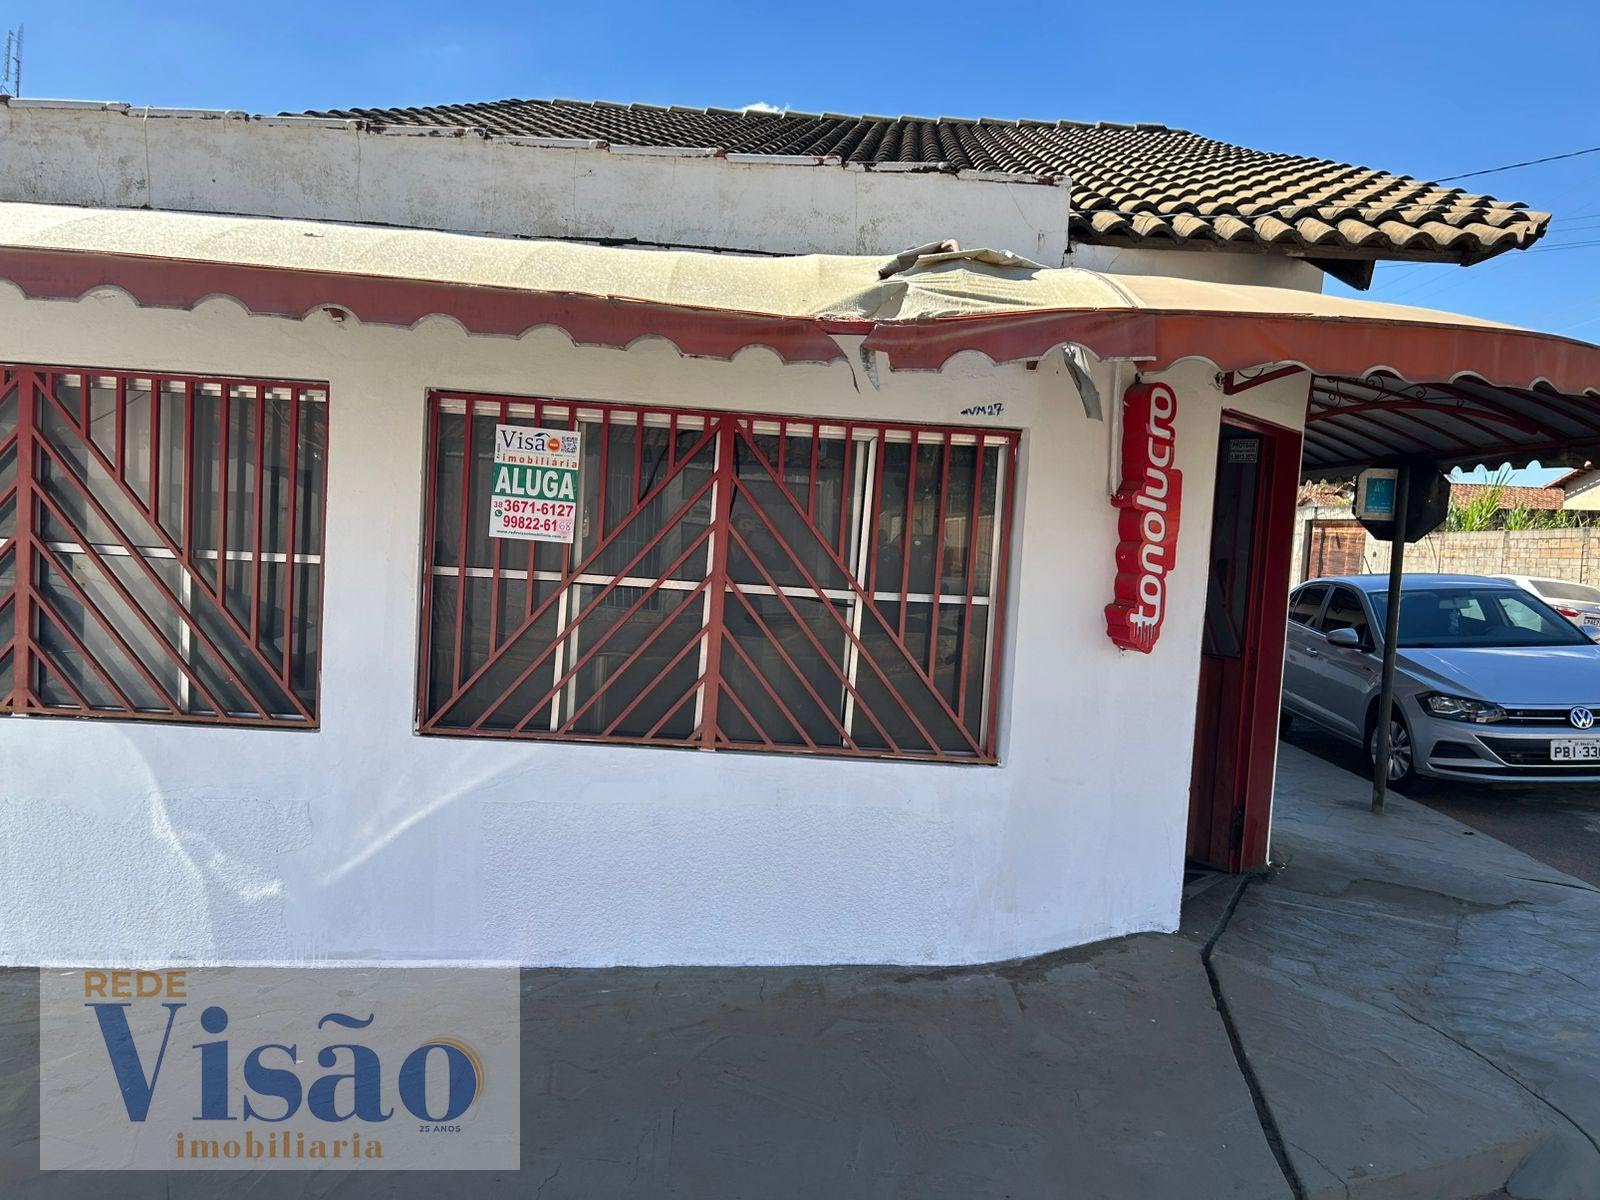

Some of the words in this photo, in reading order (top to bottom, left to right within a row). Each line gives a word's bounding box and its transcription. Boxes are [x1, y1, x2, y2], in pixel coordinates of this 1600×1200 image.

[495, 466, 575, 500] ALUGA
[503, 499, 574, 517] 3671-6127
[1130, 387, 1172, 628] tonolucro
